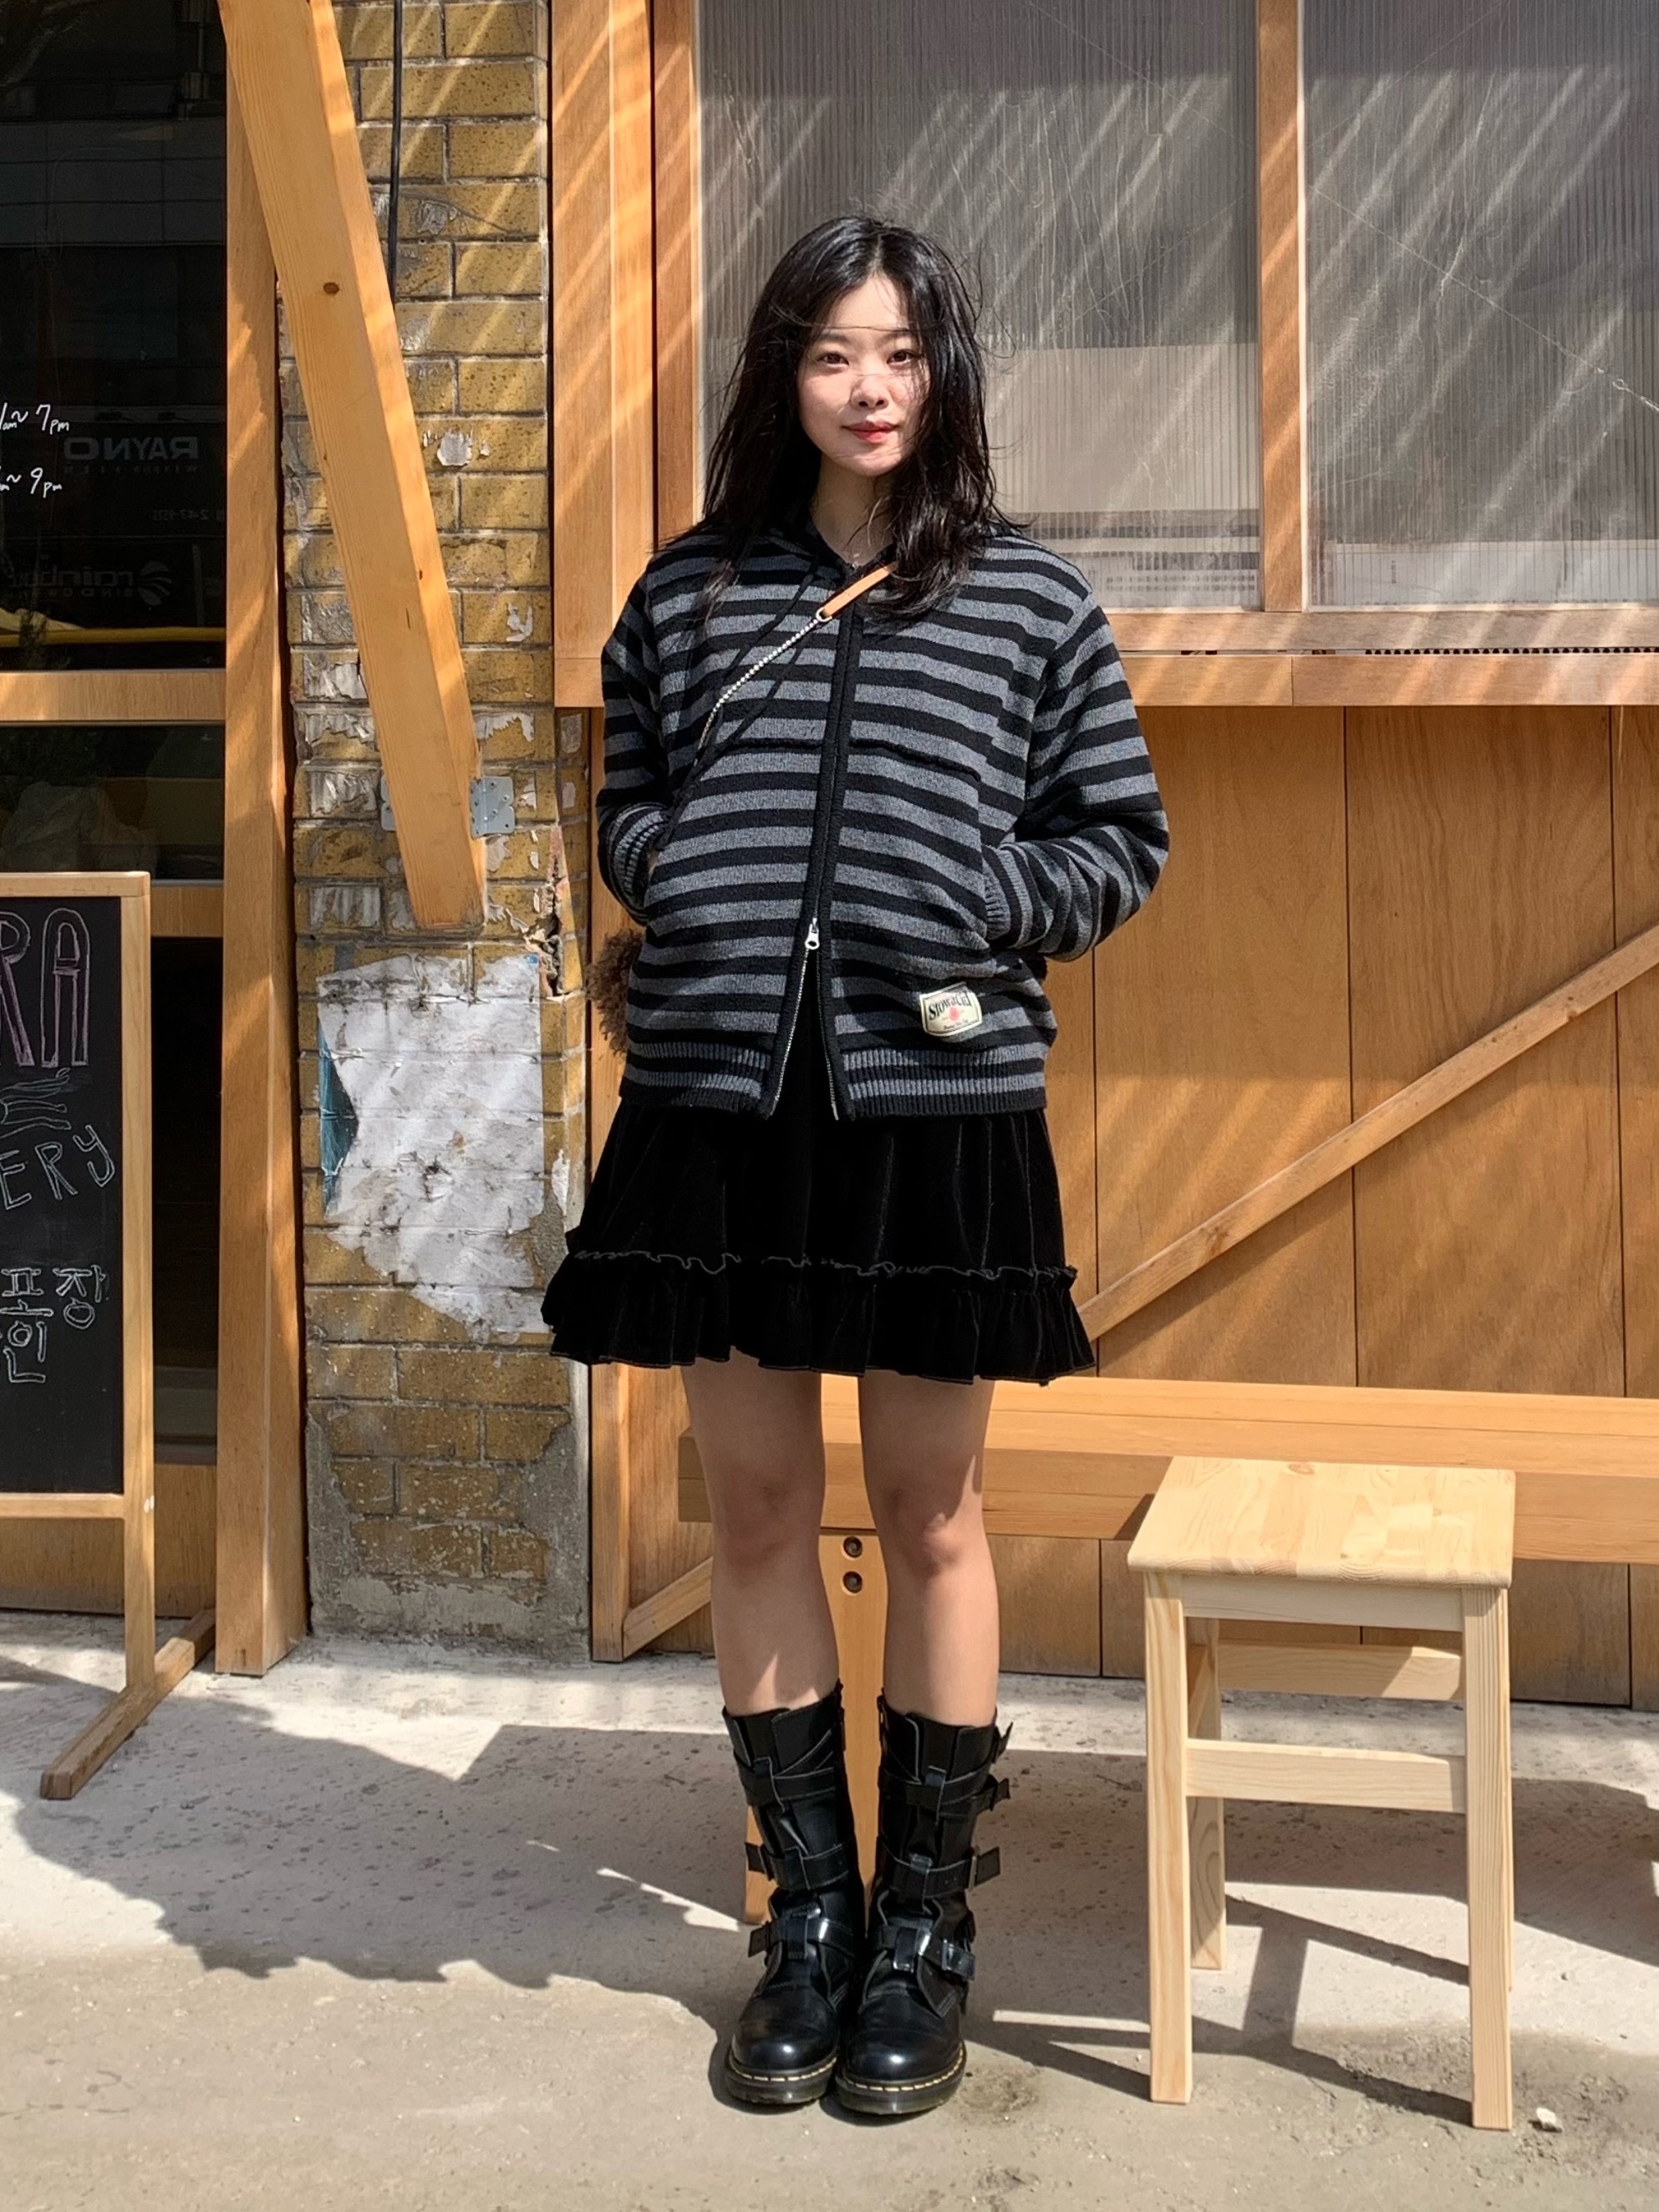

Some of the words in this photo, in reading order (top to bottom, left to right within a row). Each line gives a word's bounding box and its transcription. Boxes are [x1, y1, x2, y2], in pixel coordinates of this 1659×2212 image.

[36, 404, 69, 435] 7pm
[30, 467, 63, 498] 9pm
[0, 1264, 106, 1329] 포장
[0, 1317, 47, 1383] 인
